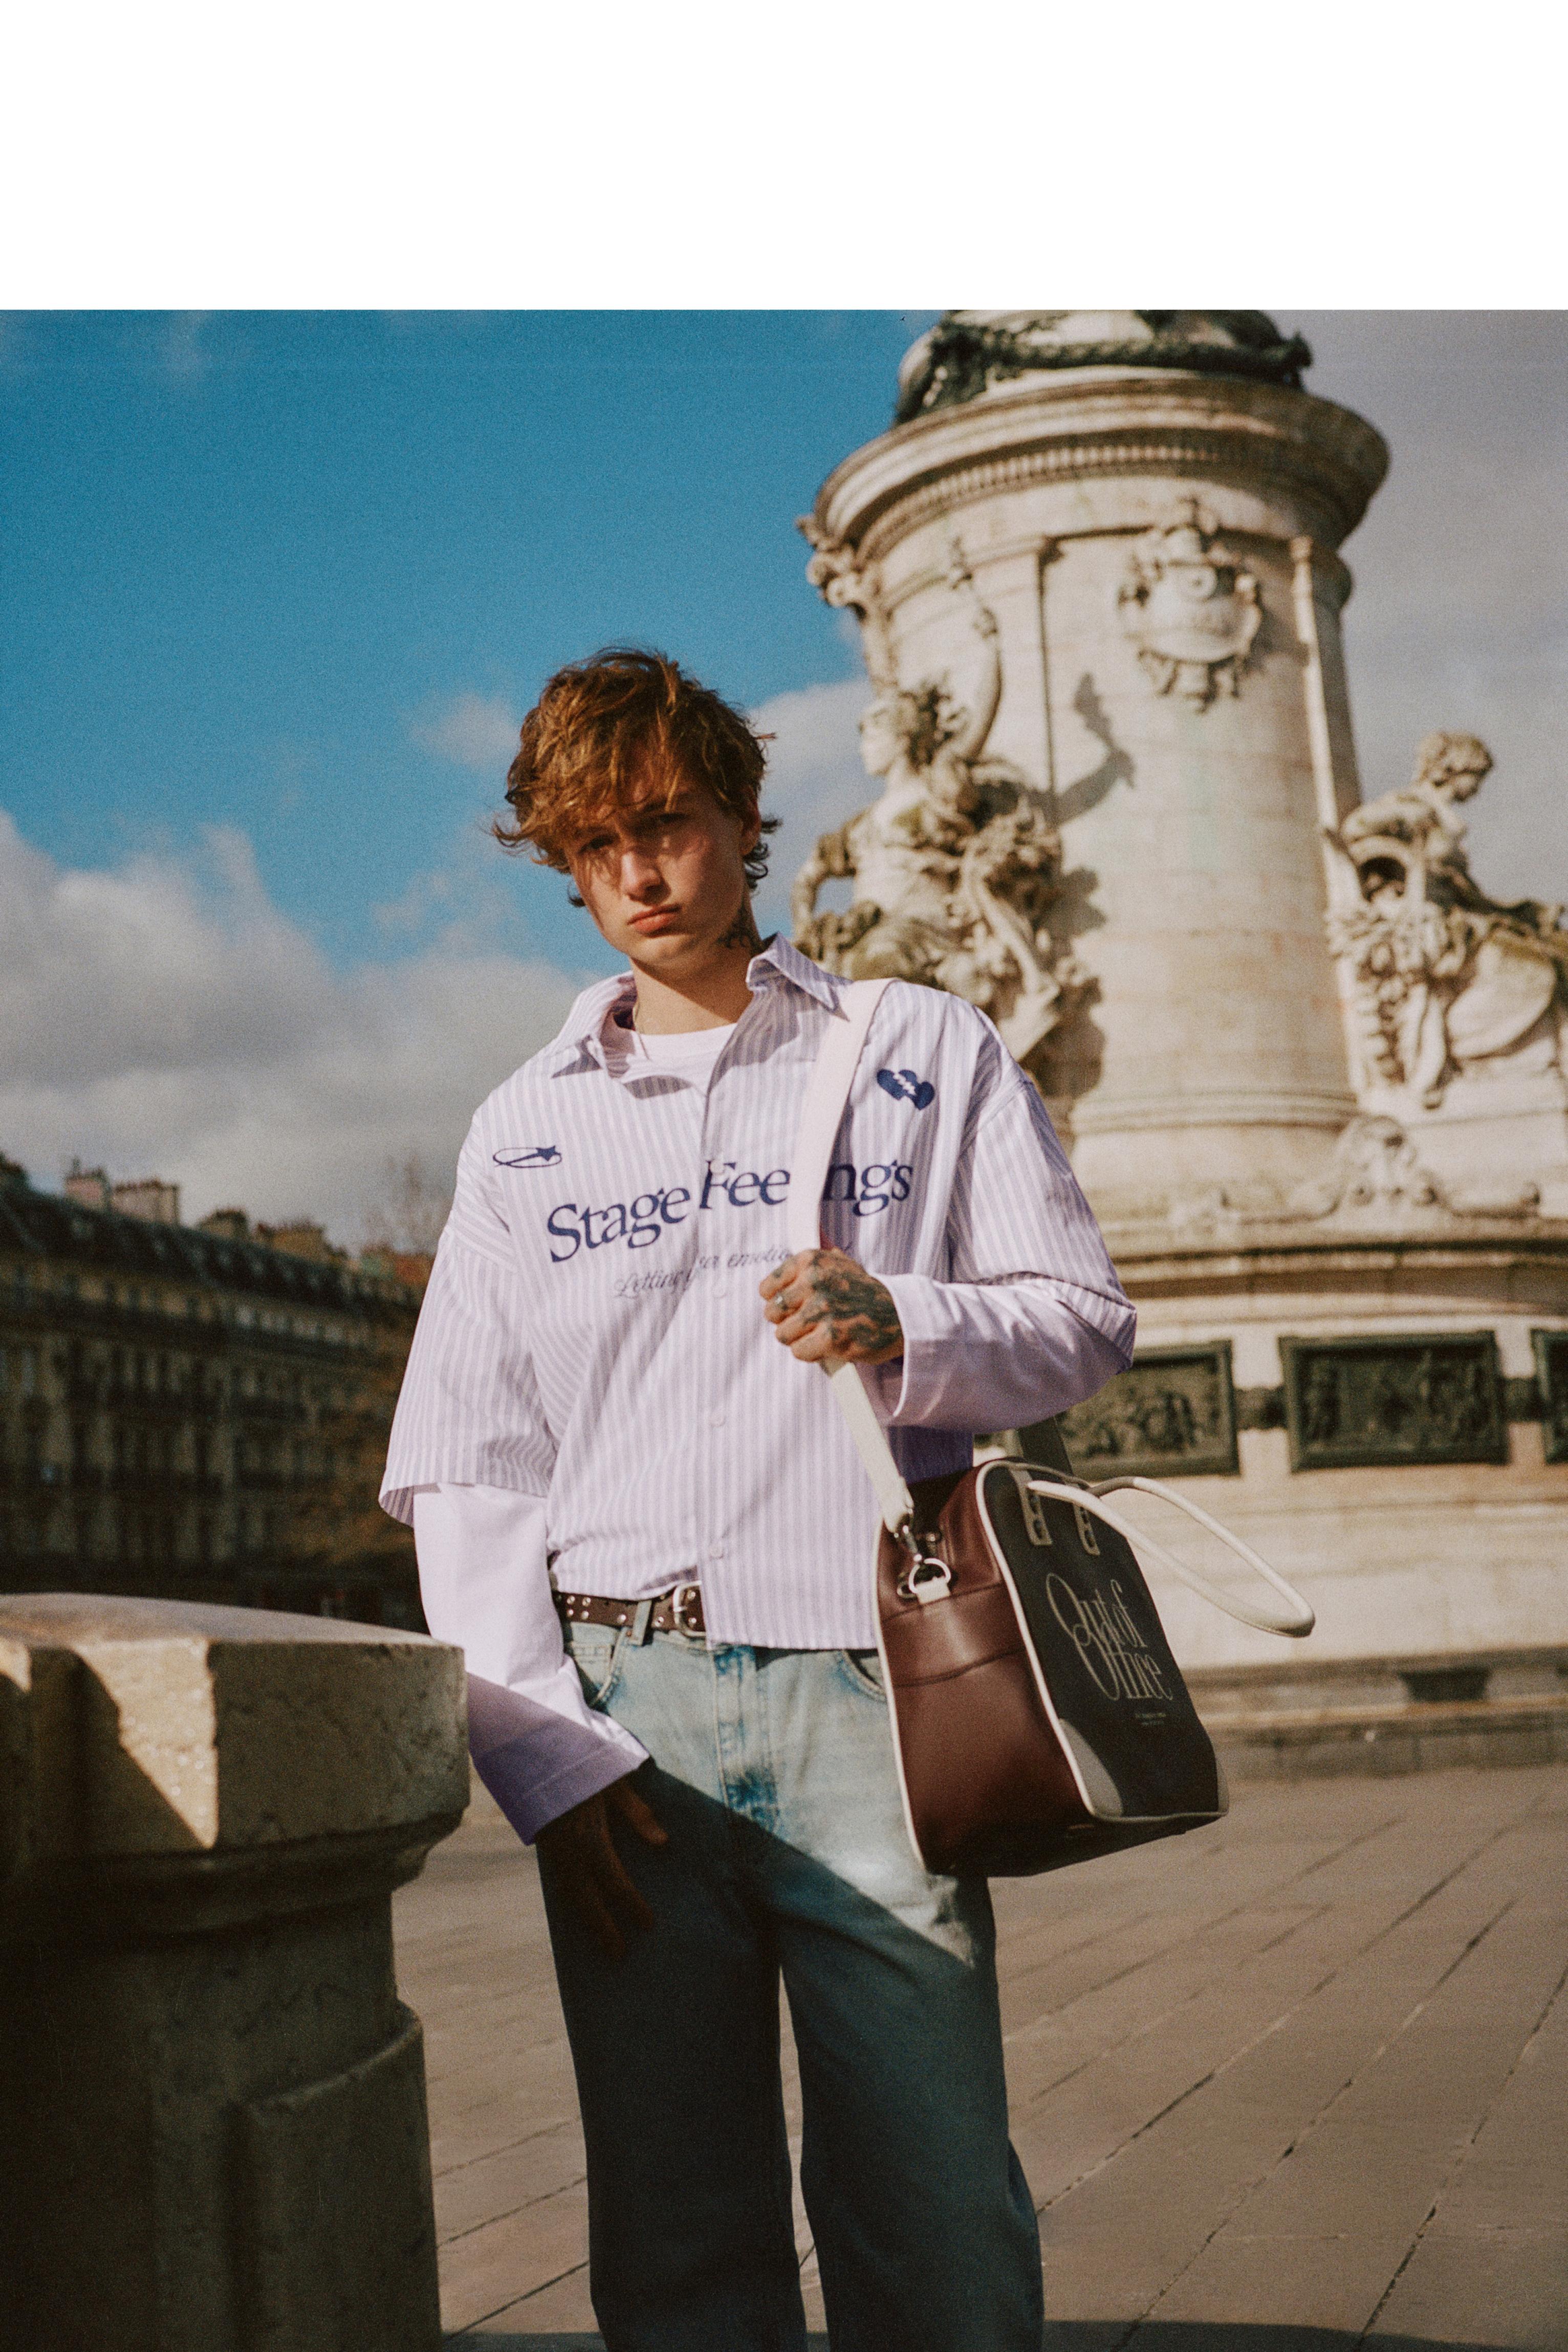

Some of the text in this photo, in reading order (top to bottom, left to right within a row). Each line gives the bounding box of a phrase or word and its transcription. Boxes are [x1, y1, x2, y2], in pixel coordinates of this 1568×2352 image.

[547, 1159, 913, 1262] Stage Feengs
[1046, 1572, 1148, 1648] Out of
[1073, 1622, 1173, 1702] Office
